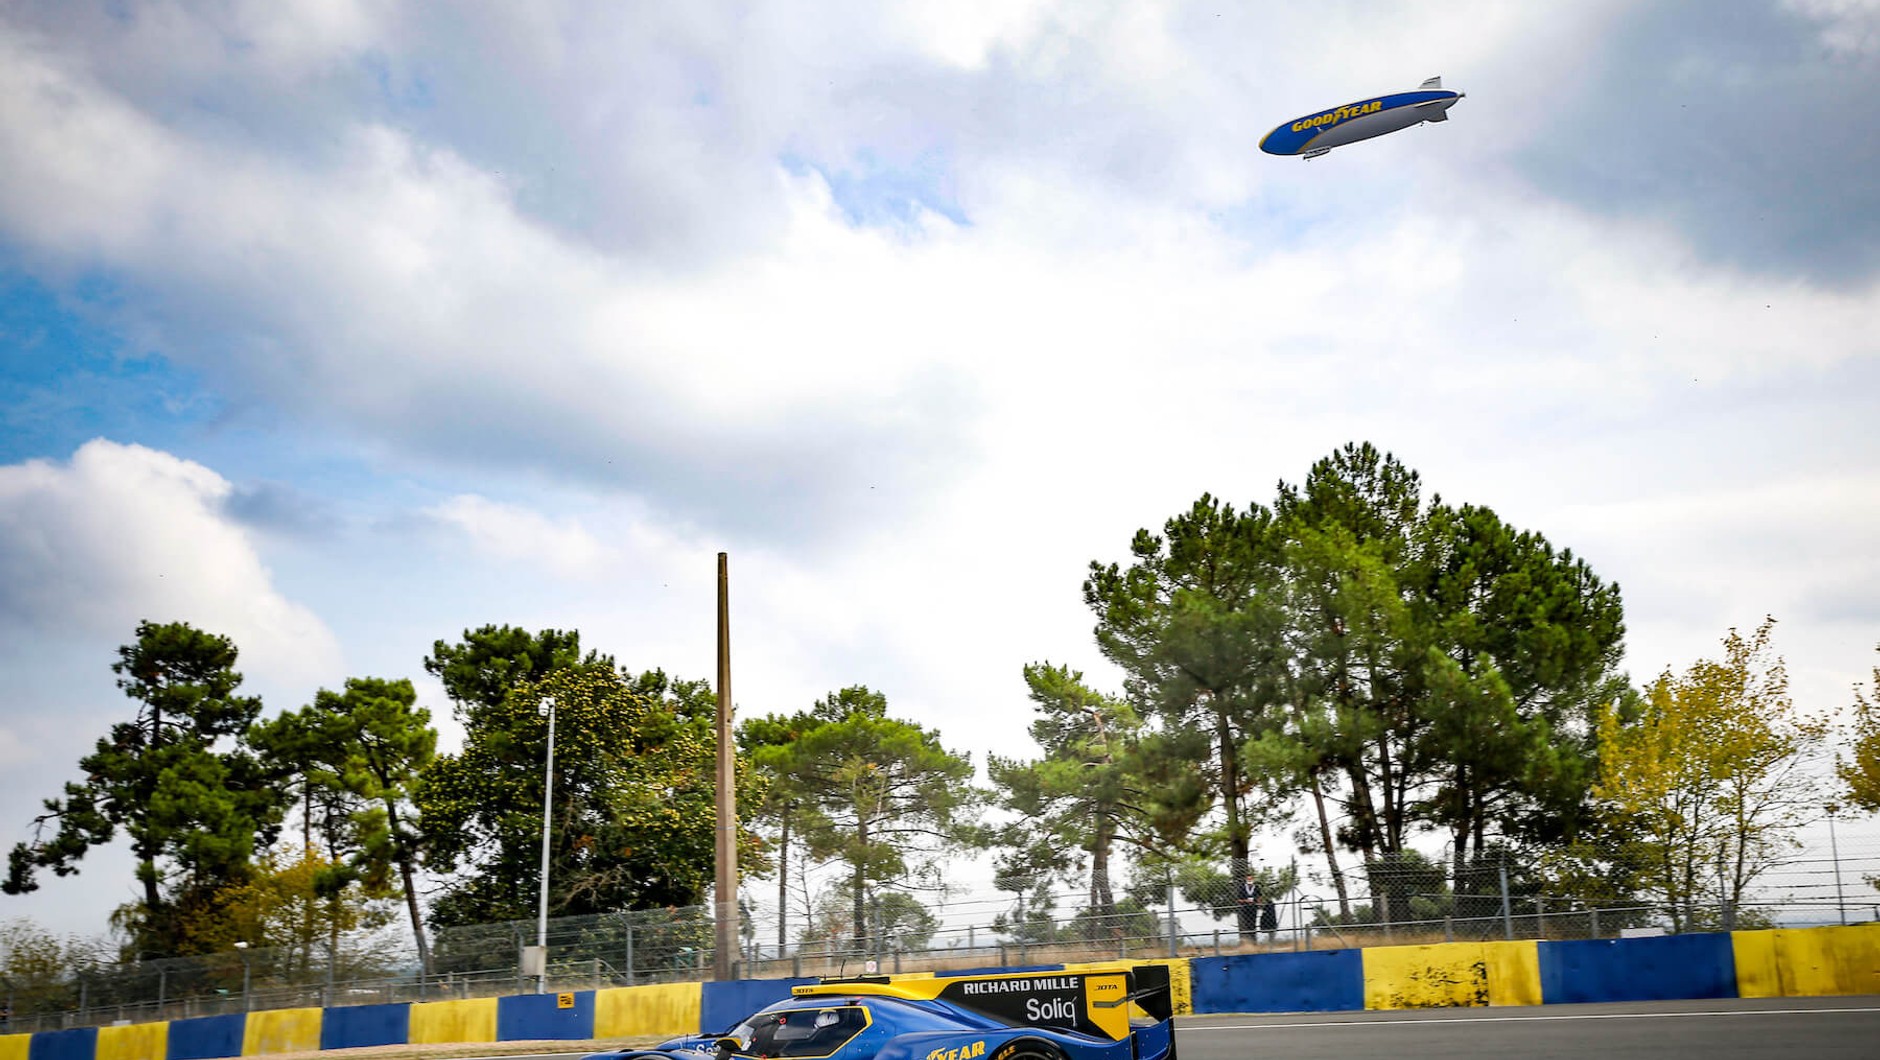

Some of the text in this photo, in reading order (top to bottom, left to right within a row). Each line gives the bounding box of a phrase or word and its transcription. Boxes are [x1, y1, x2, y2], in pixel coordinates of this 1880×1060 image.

[1292, 101, 1382, 132] GOODYEAR
[963, 977, 1079, 994] RICHARD MILLE
